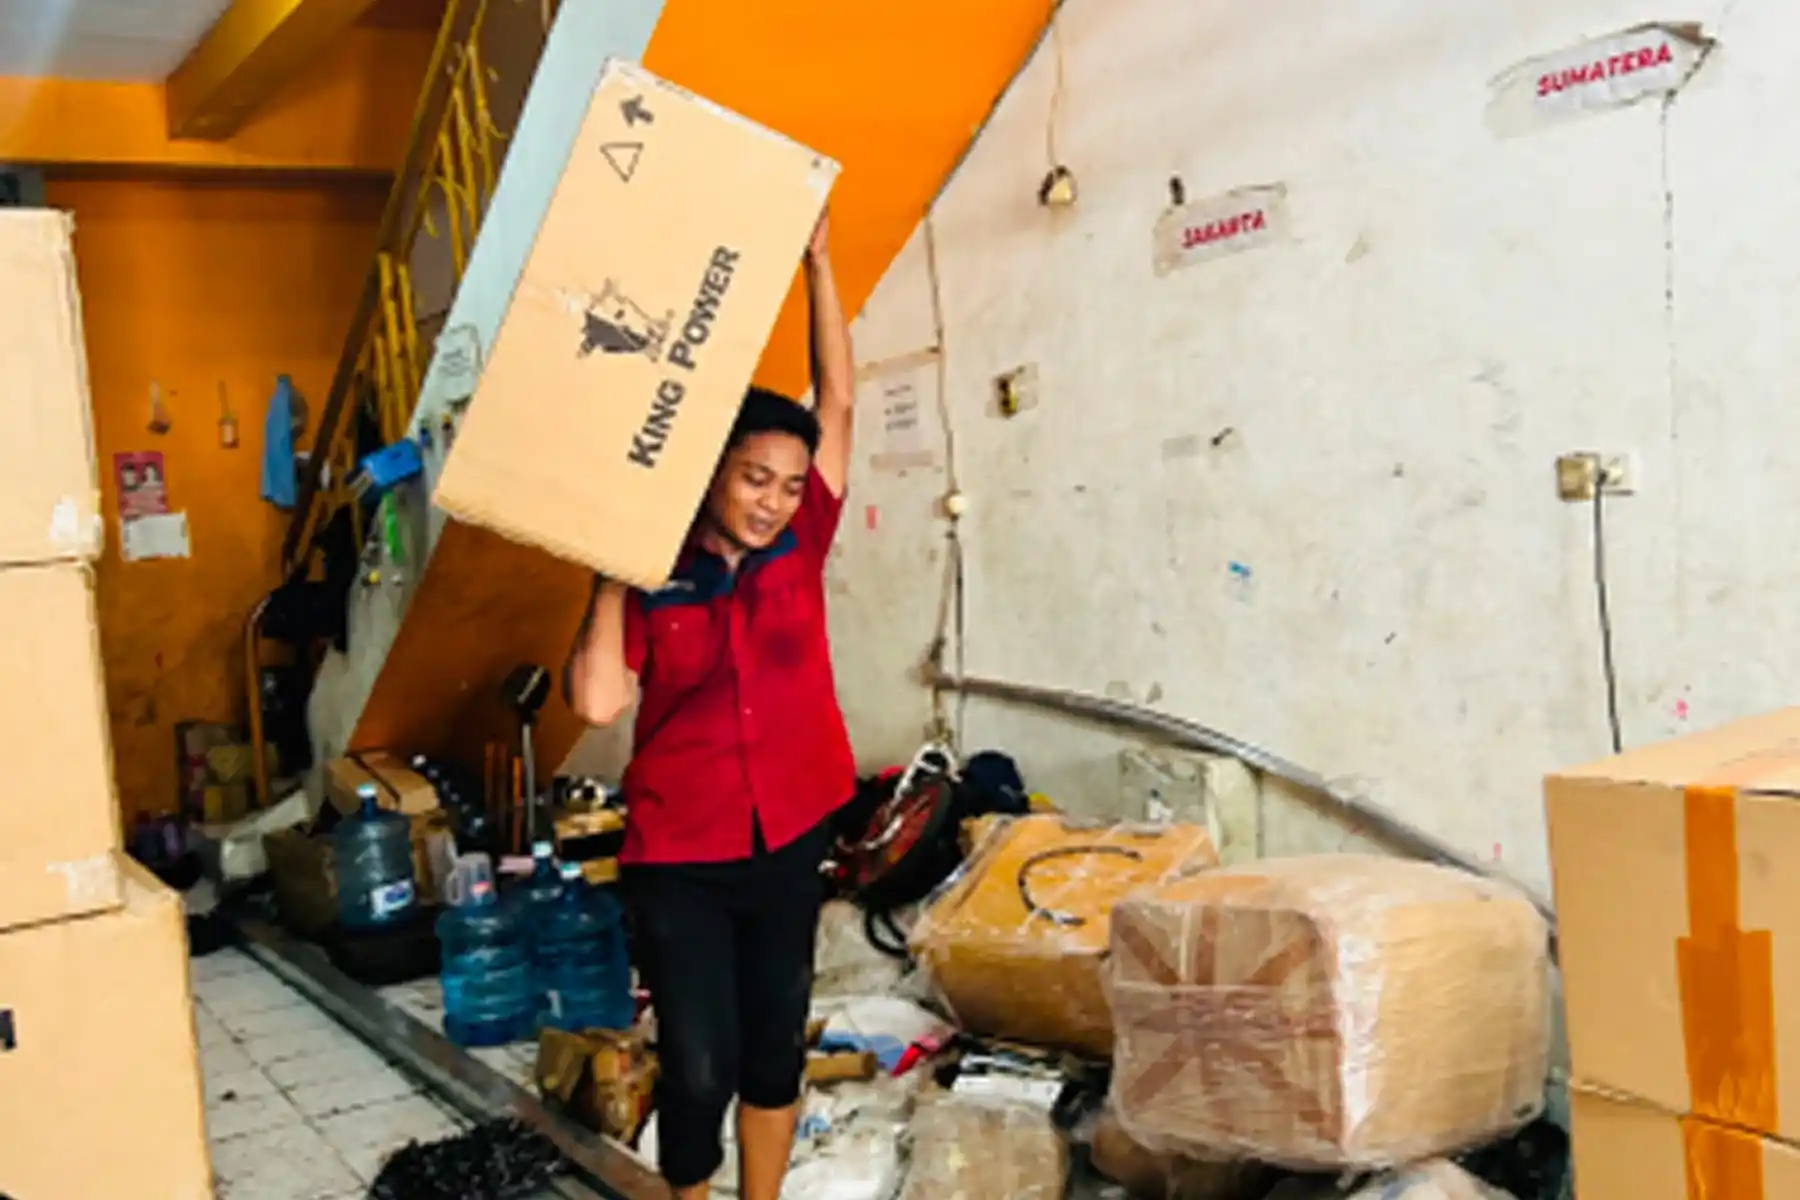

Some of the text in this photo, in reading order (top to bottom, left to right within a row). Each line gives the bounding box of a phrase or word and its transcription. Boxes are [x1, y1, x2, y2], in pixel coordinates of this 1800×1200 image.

[1537, 42, 1673, 97] SUMATERA
[1182, 209, 1266, 249] JAKARTA
[627, 245, 740, 468] KING POWER
